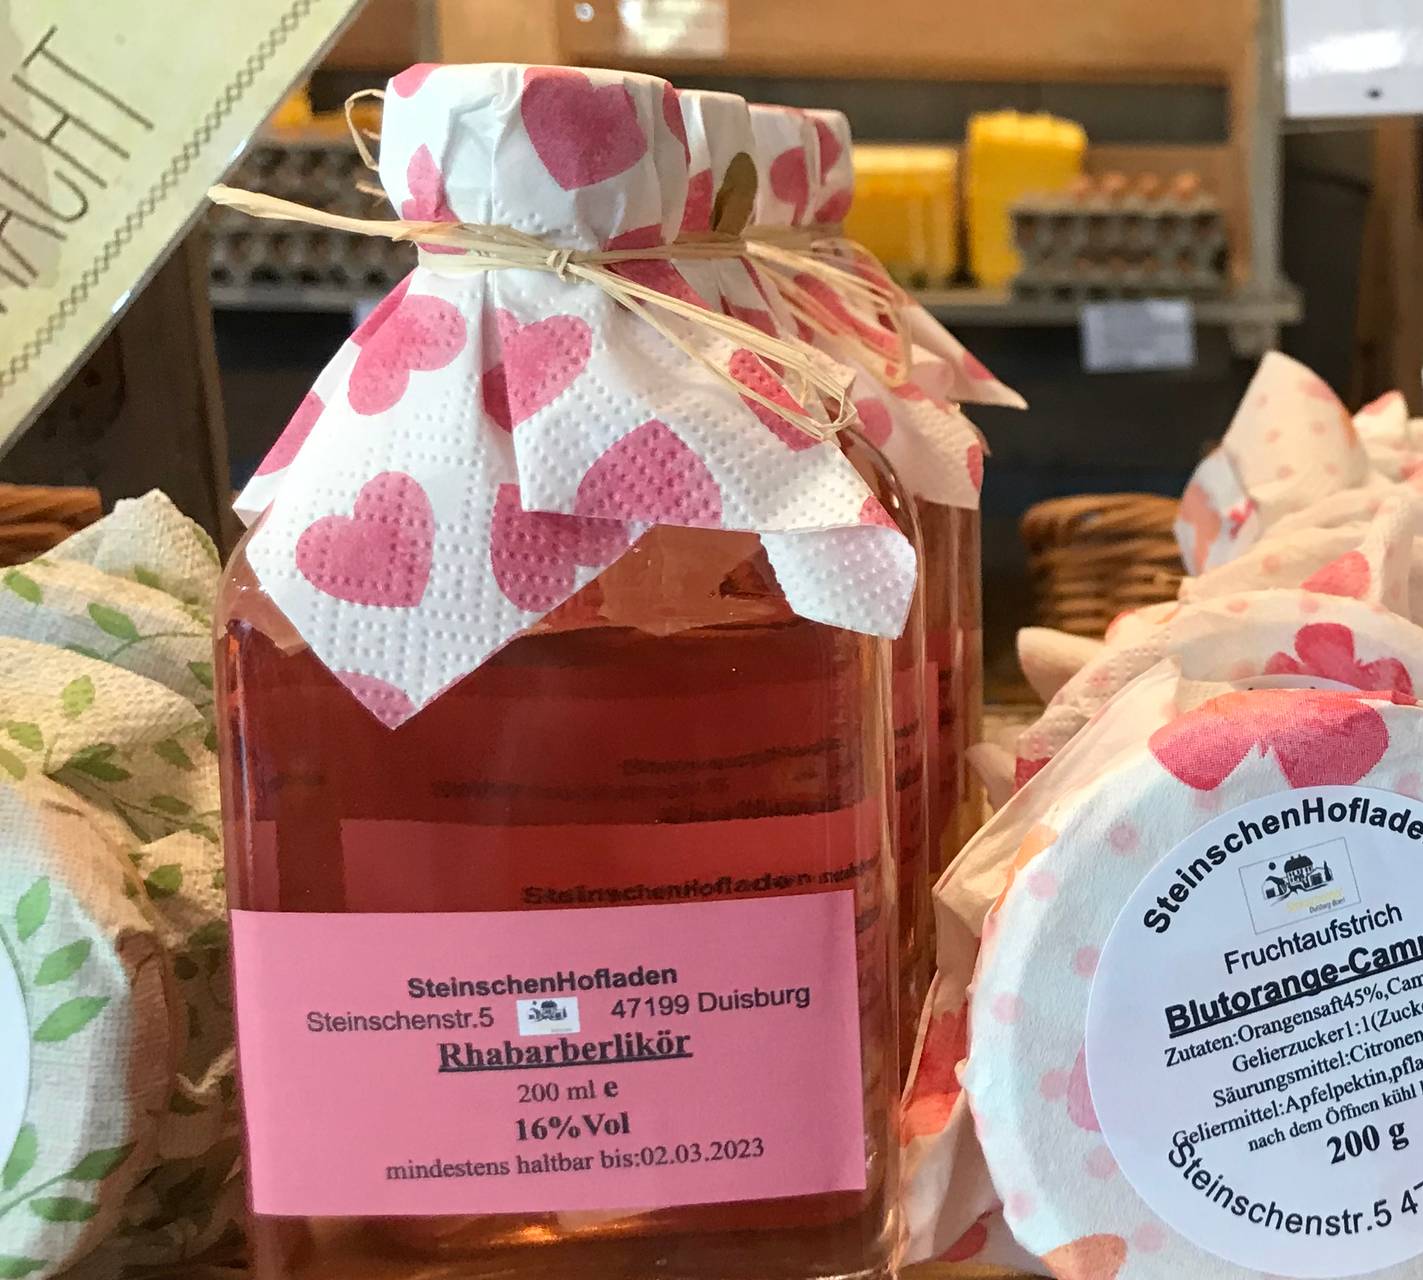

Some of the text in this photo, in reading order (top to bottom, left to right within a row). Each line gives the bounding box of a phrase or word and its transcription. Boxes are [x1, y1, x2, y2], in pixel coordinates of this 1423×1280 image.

[0, 26, 155, 314] ACHT
[1224, 903, 1402, 974] Fruchtaufstrich
[408, 965, 677, 1000] SteinschenHofladen
[306, 984, 811, 1034] Steinschenstr.5 47199 Duisburg
[438, 1030, 692, 1073] Rhabarberlikör
[517, 1082, 559, 1103] 200
[566, 1079, 597, 1101] ml
[1248, 1129, 1286, 1152] nach
[1290, 1117, 1323, 1141] dem
[1325, 1103, 1380, 1131] Öffnen
[1383, 1084, 1417, 1107] kühl
[386, 1138, 765, 1181] mindestens haltbar bis:02.03.2023
[1327, 1122, 1409, 1165] 200 g
[1168, 1139, 1392, 1236] Steinschenstr.5
